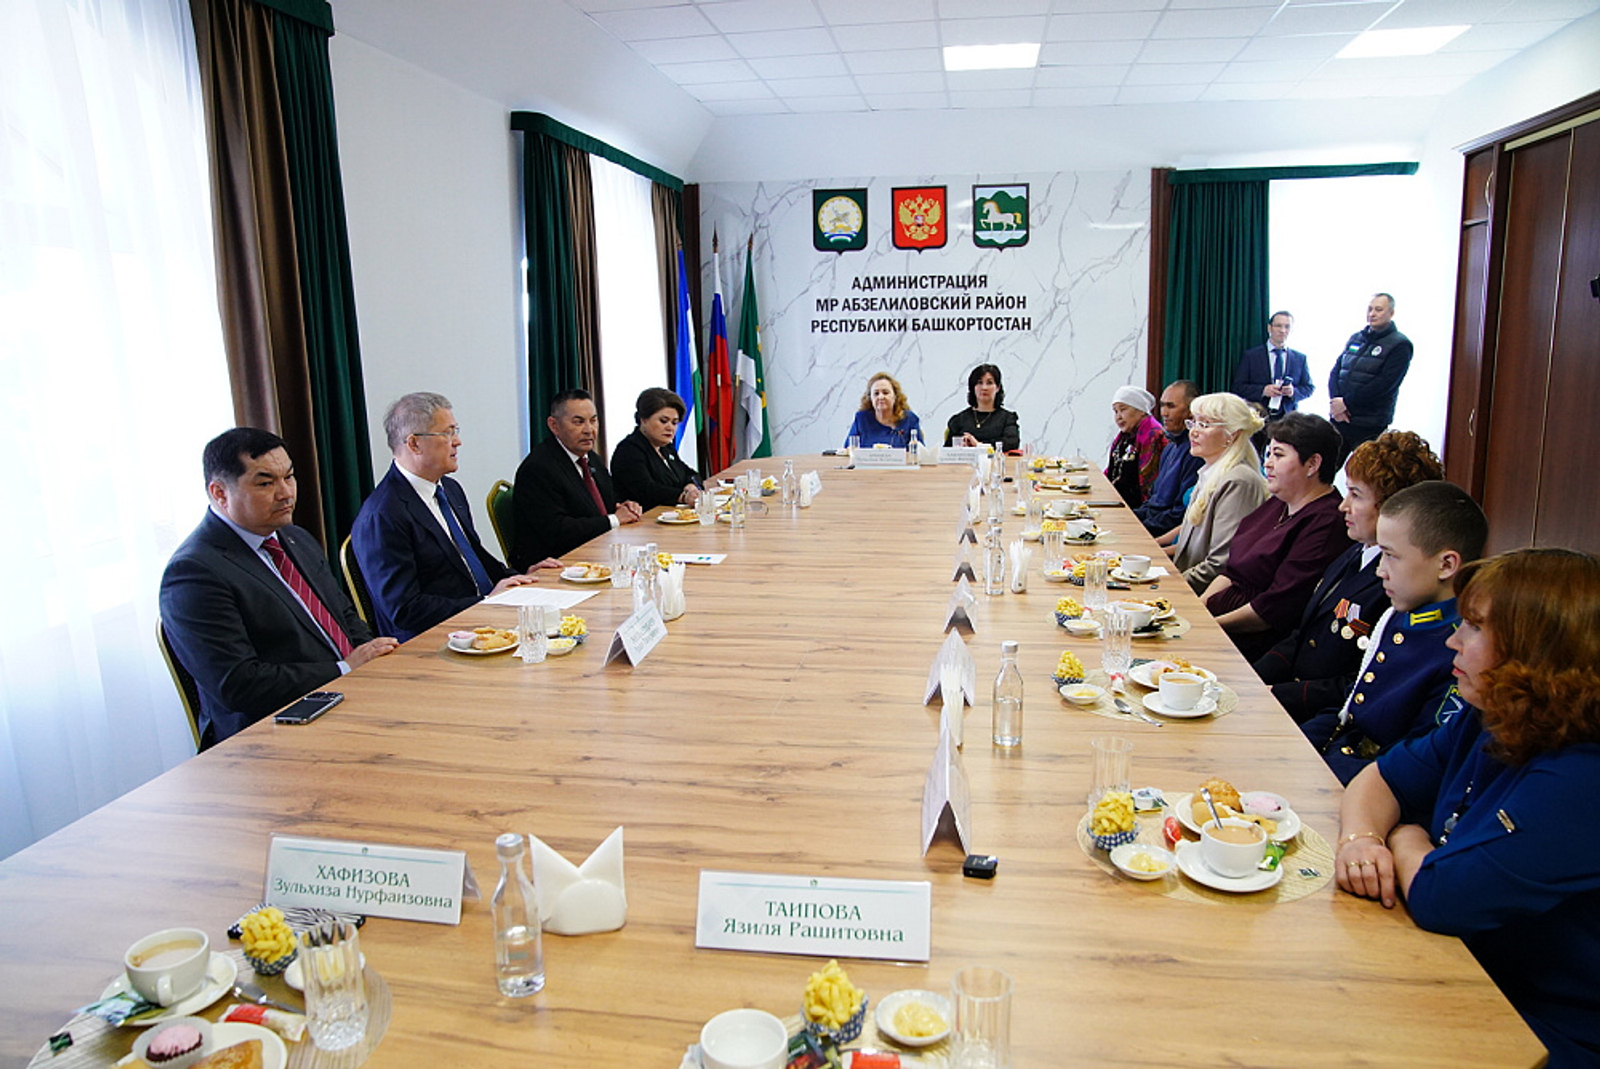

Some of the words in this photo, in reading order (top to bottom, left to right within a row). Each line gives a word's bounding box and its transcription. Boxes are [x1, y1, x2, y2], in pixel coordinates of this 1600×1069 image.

[852, 274, 988, 291] АДМИНИСТРАЦИЯ
[816, 299, 838, 312] МР
[842, 294, 971, 312] АБЗЕЛИЛОВСКИЙ
[976, 292, 1027, 310] РАЙОН
[811, 319, 907, 333] РЕСПУБЛИКИ
[912, 316, 1032, 332] БАШКОРТОСТАН
[316, 865, 410, 887] ХАФИЗОВА
[274, 877, 341, 898] Зульхиза
[765, 901, 862, 921] ТАИПОВА
[723, 917, 781, 936] Язиля
[789, 921, 904, 943] Рашитовна
